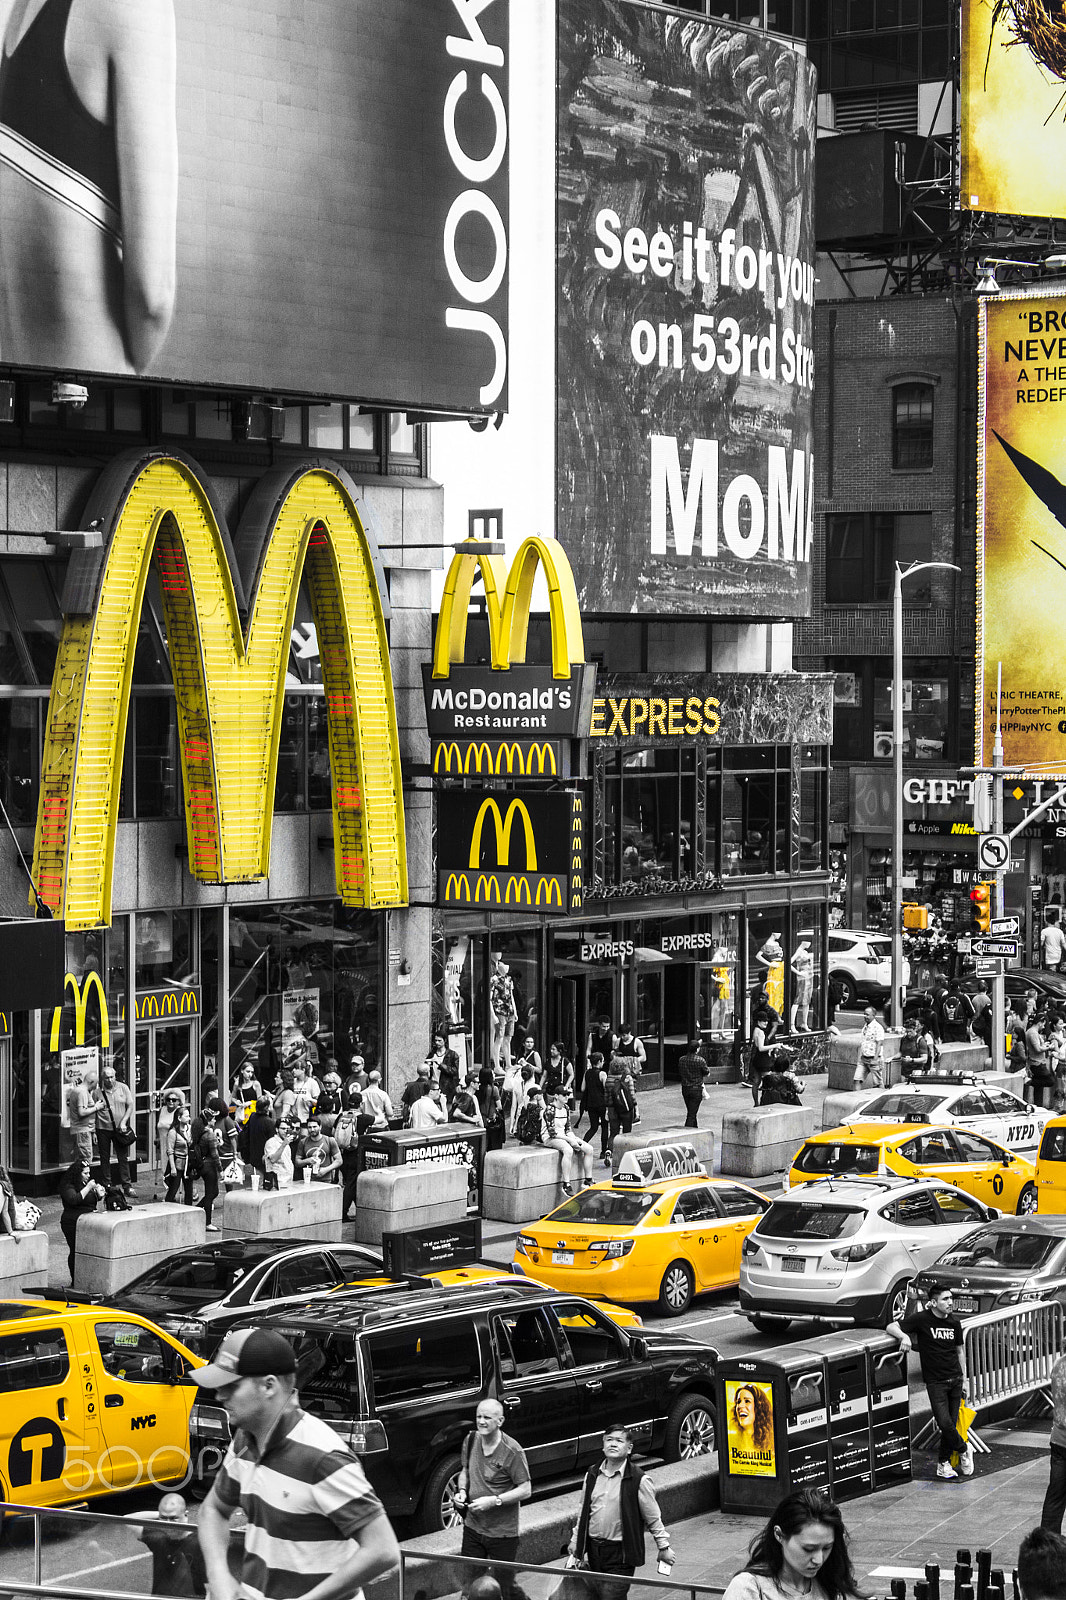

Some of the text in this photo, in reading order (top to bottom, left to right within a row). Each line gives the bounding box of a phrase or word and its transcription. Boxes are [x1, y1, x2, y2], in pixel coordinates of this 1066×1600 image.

[594, 208, 674, 278] See
[682, 220, 712, 284] it
[718, 228, 773, 293] for
[630, 319, 683, 369] on
[691, 313, 776, 380] 53rd
[1017, 366, 1066, 382] A THE
[431, 687, 572, 710] McDonald's
[1019, 691, 1063, 700] THEATRE,
[454, 714, 547, 728] Restaurant
[590, 697, 721, 736] EXPRESS
[903, 778, 975, 805] GIFT
[918, 823, 984, 834] Apple Nik
[963, 872, 982, 883] W 46
[581, 940, 634, 961] EXPRESS
[661, 933, 712, 952] EXPRESS
[998, 945, 1014, 953] WAY
[206, 1060, 214, 1070] A
[1007, 1123, 1035, 1143] NYPD
[406, 1141, 468, 1161] BROADWAY'S
[930, 1327, 955, 1340] VANS
[130, 1414, 157, 1431] NYC
[732, 1447, 772, 1461] Beautiful
